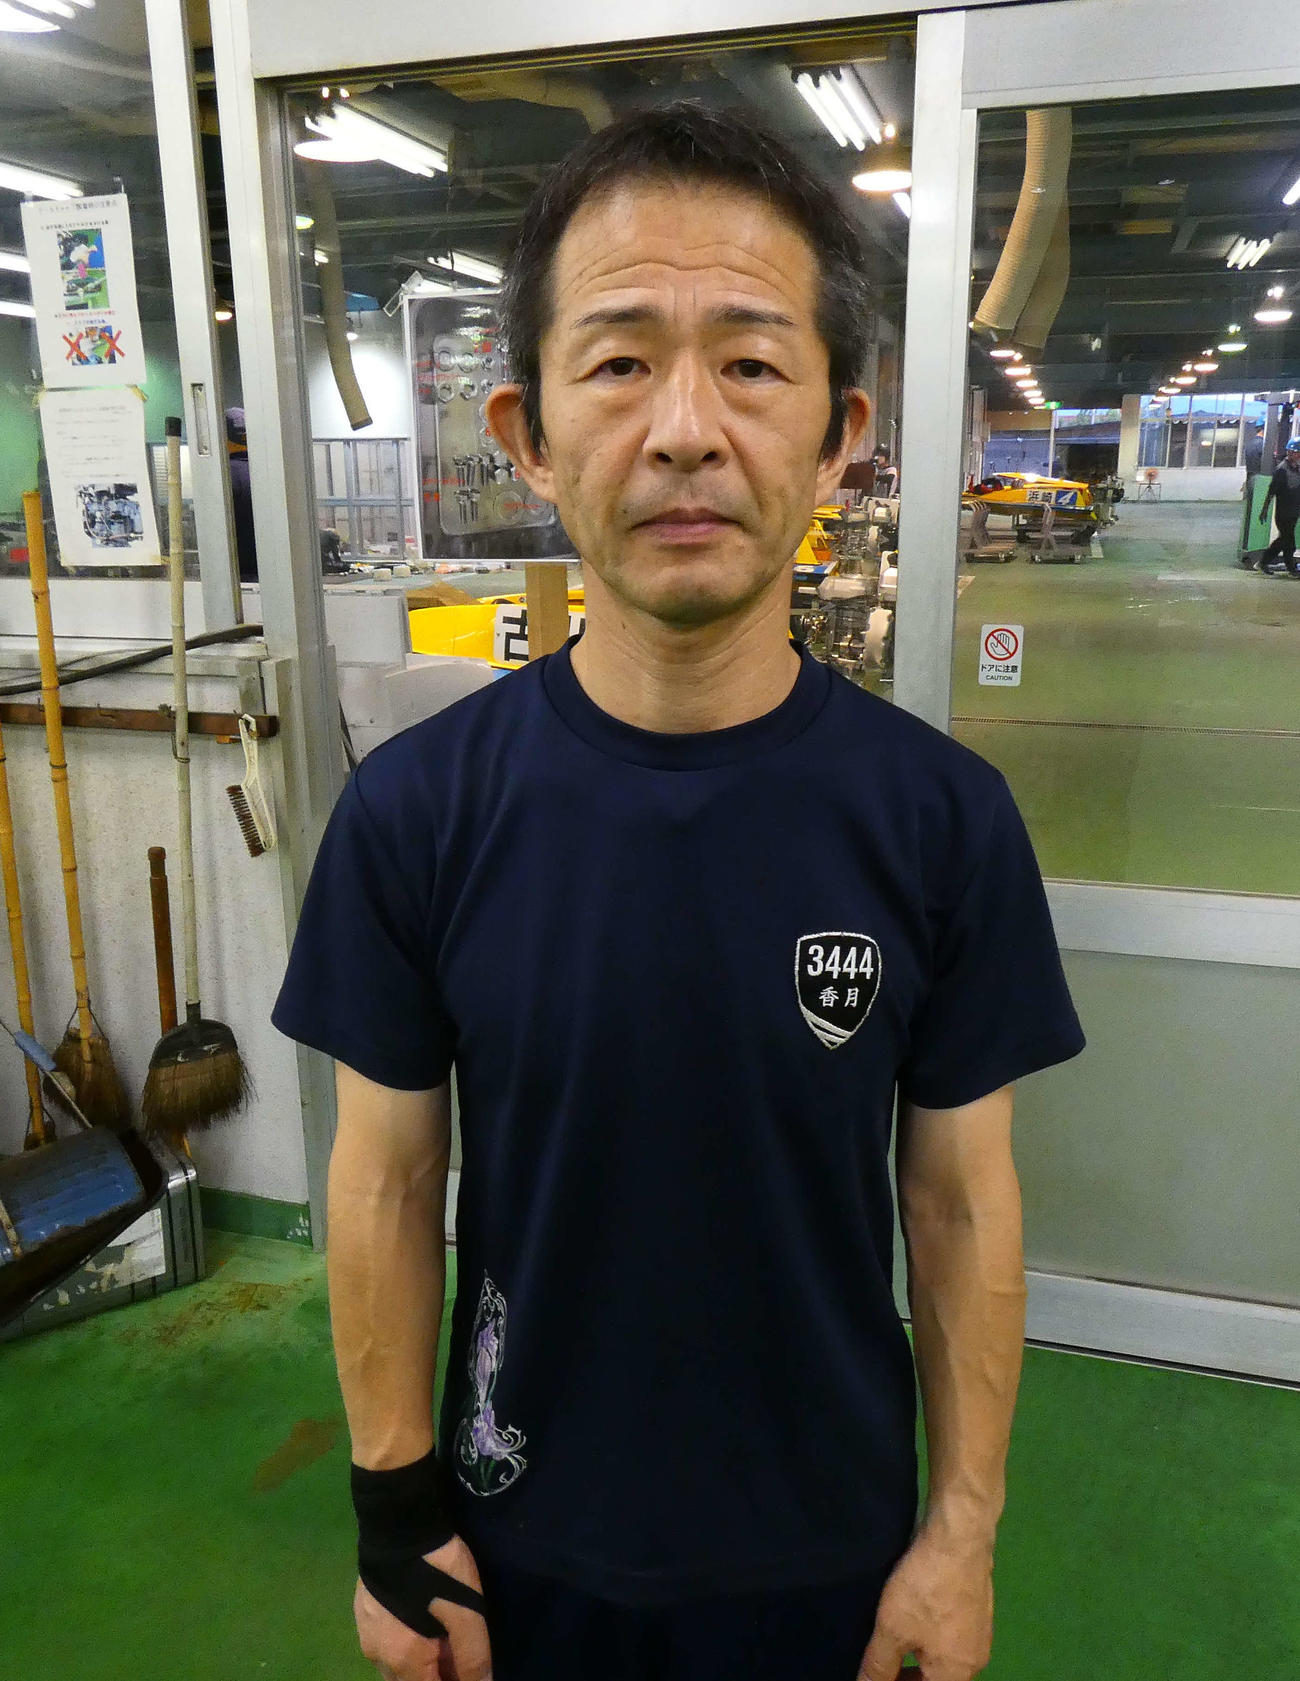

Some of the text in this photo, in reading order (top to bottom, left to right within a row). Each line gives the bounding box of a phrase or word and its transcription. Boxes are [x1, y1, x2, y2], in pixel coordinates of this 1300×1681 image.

[1057, 491, 1075, 505] 4
[981, 664, 1018, 673] ドアに注意
[807, 945, 874, 980] 3444
[819, 986, 859, 1008] 香月
